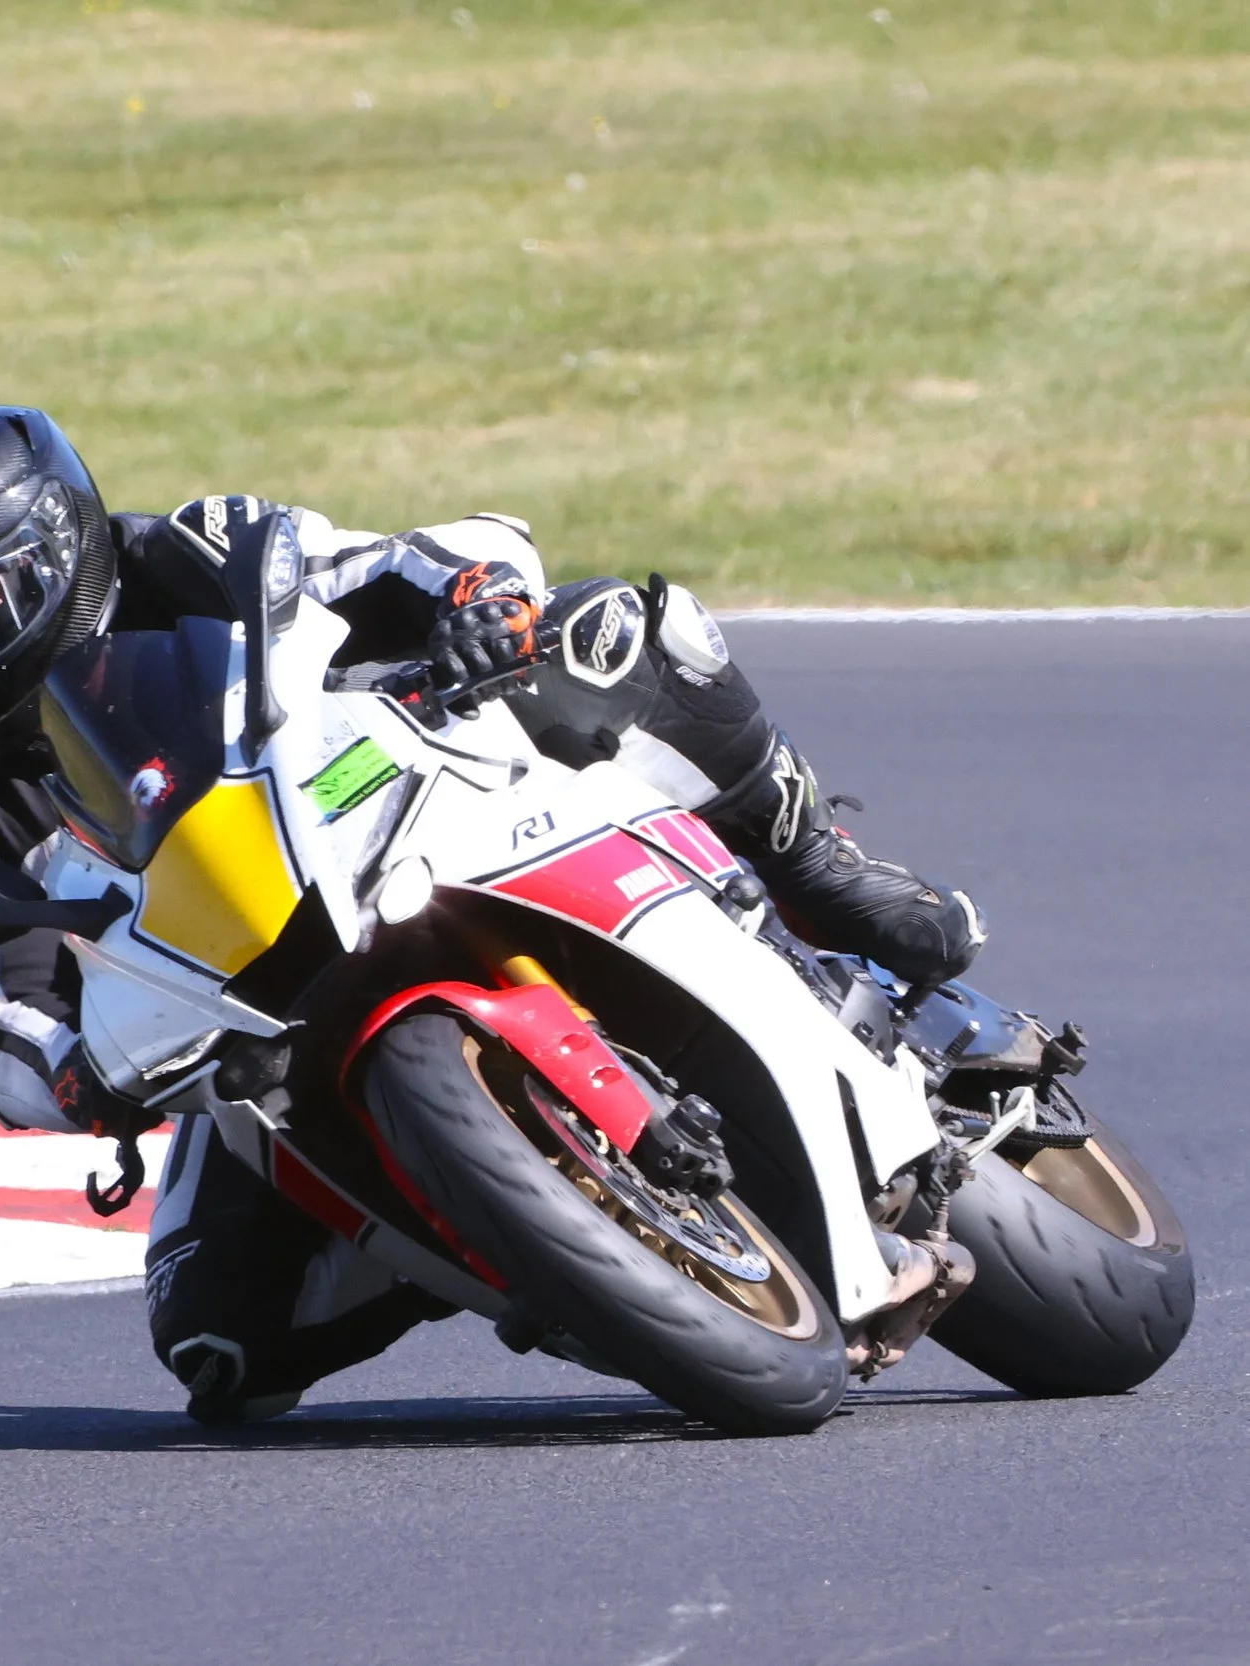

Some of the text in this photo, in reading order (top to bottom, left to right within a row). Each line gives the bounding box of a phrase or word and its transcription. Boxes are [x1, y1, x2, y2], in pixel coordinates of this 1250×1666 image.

[590, 592, 627, 672] RST
[675, 664, 713, 687] RST
[512, 811, 556, 851] R1
